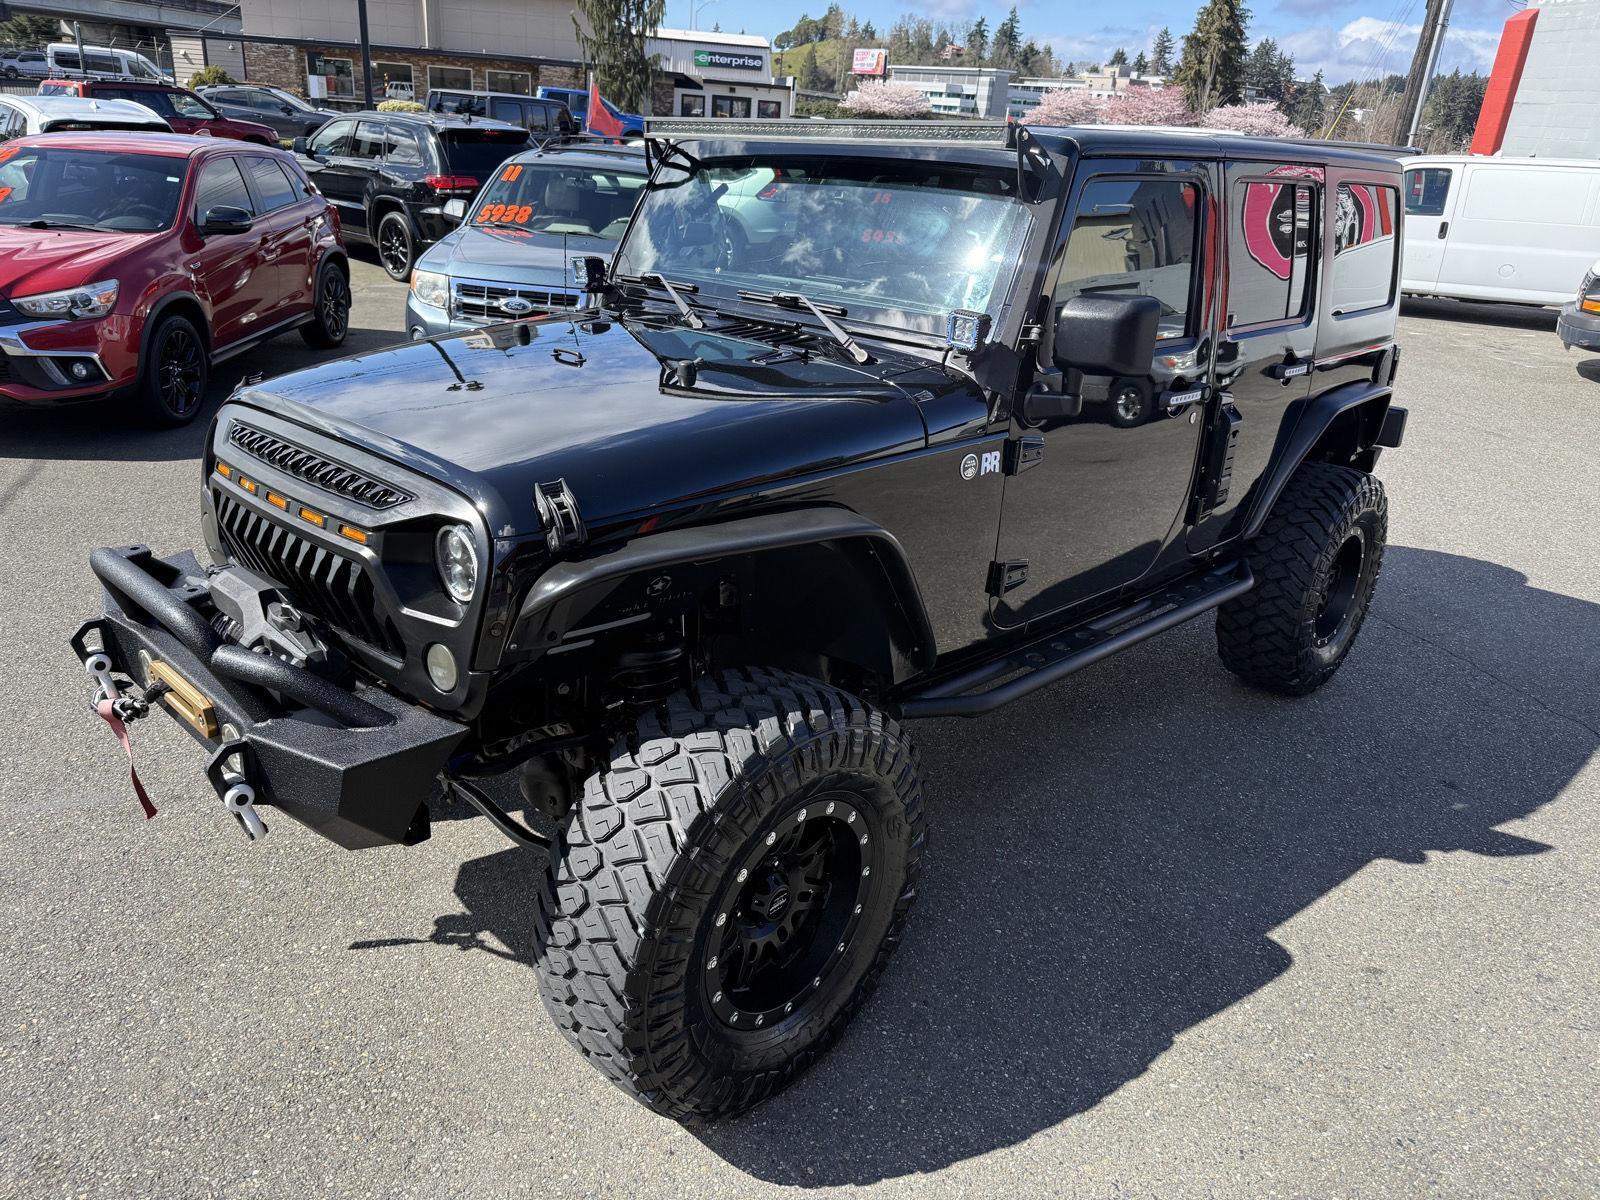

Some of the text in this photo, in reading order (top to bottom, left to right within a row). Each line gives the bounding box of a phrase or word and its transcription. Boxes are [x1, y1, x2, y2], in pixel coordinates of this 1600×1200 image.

[697, 54, 762, 66] enterprise
[501, 165, 523, 182] 11
[476, 204, 533, 224] 5938
